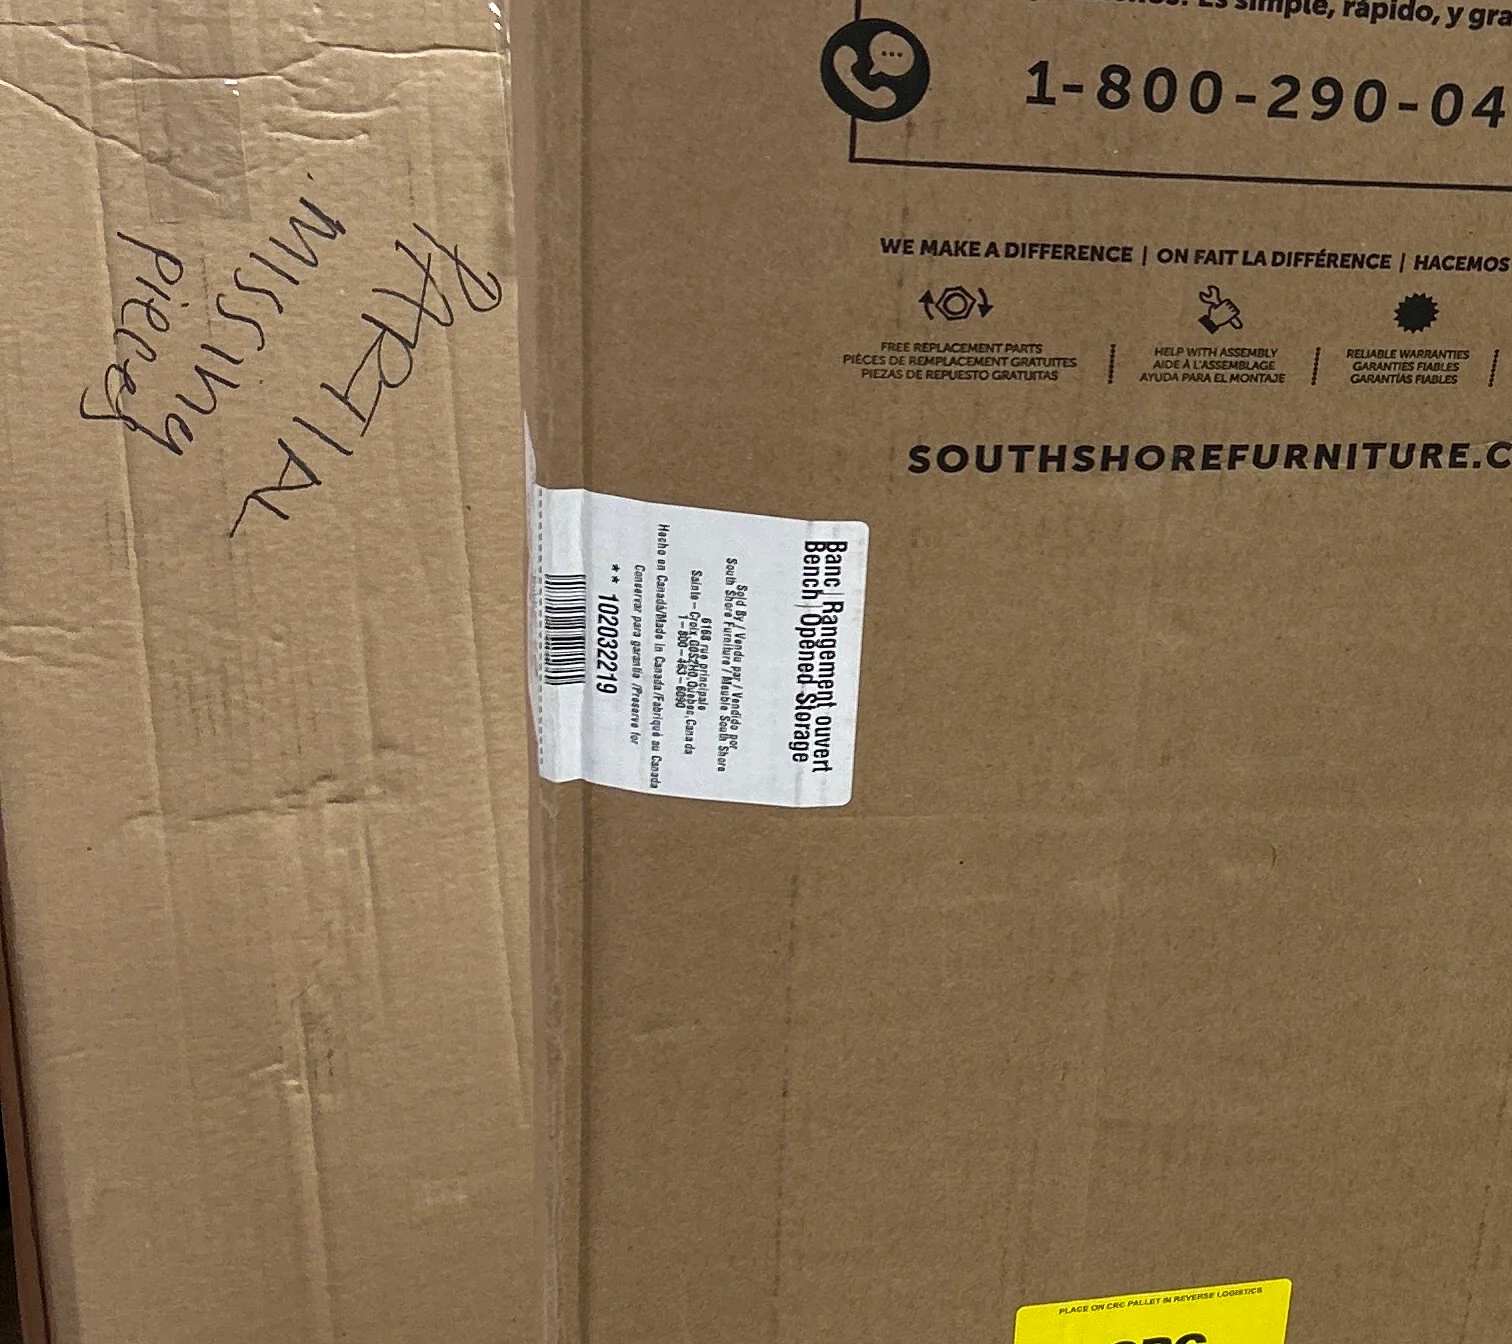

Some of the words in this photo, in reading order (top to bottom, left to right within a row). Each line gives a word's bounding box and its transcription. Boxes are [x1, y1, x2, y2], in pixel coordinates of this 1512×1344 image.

[1445, 6, 1464, 28] y
[880, 237, 914, 254] WE
[919, 239, 980, 257] MAKE
[983, 241, 1000, 257] A
[1004, 241, 1133, 262] DIFFERENCE
[1156, 247, 1188, 263] ON
[1193, 249, 1238, 265] FAIT
[1241, 249, 1266, 266] LA
[1271, 248, 1391, 269] DIFFÉRENCE
[1413, 254, 1510, 272] HACEMOS
[230, 222, 501, 537] PARTIAL
[800, 539, 825, 601] Bench
[823, 539, 847, 589] Banc
[596, 592, 619, 694] 102032219
[790, 611, 821, 685] Opened
[813, 599, 844, 709] Rangement
[787, 691, 816, 763] Storage
[812, 714, 836, 774] ouvert
